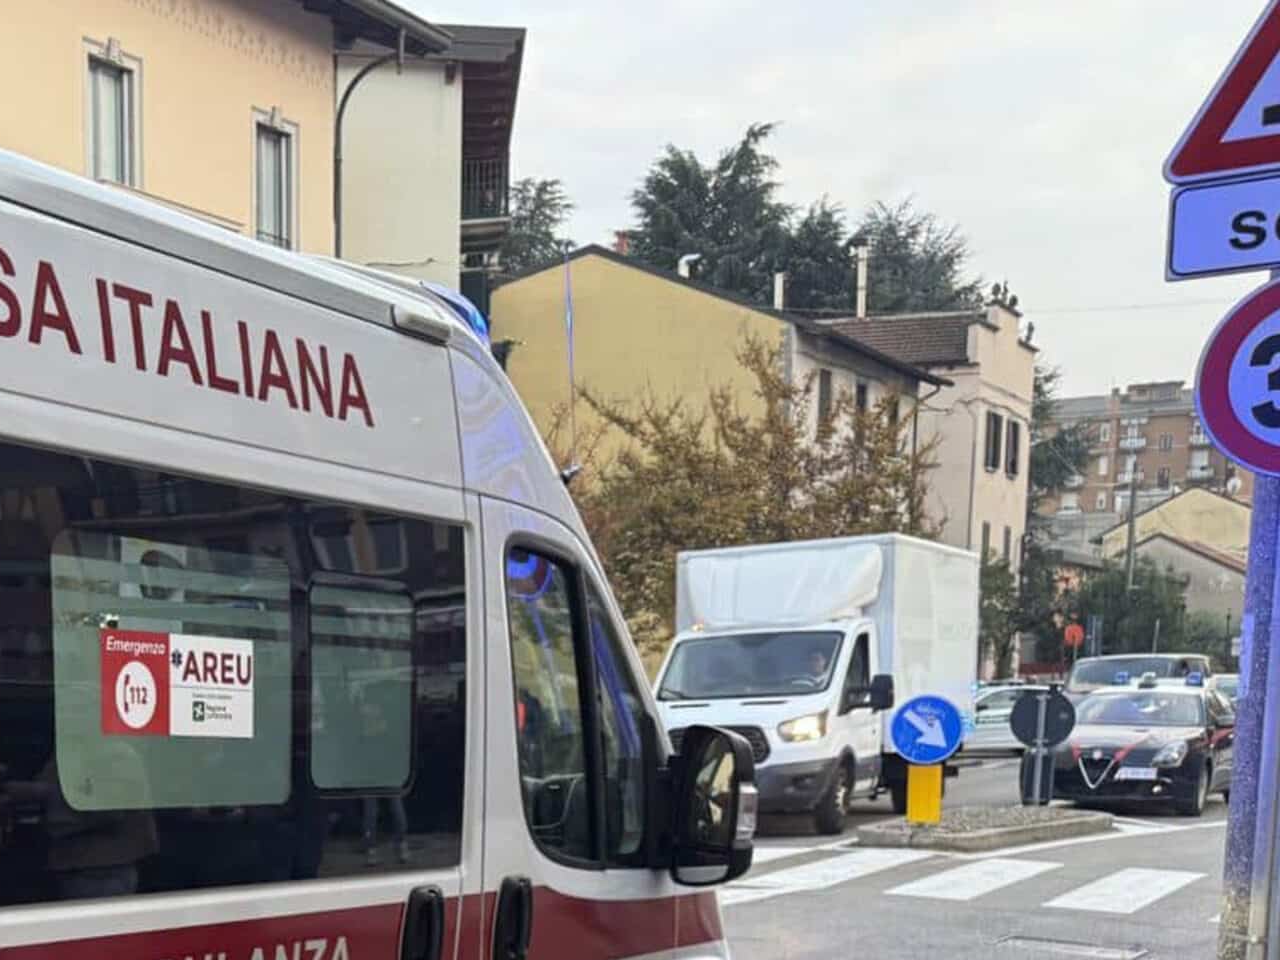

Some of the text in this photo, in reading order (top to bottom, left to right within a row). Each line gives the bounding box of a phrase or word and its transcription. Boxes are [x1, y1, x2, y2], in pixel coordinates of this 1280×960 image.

[96, 278, 375, 428] ITALIANA
[182, 650, 252, 686] AREU
[130, 686, 148, 705] 112
